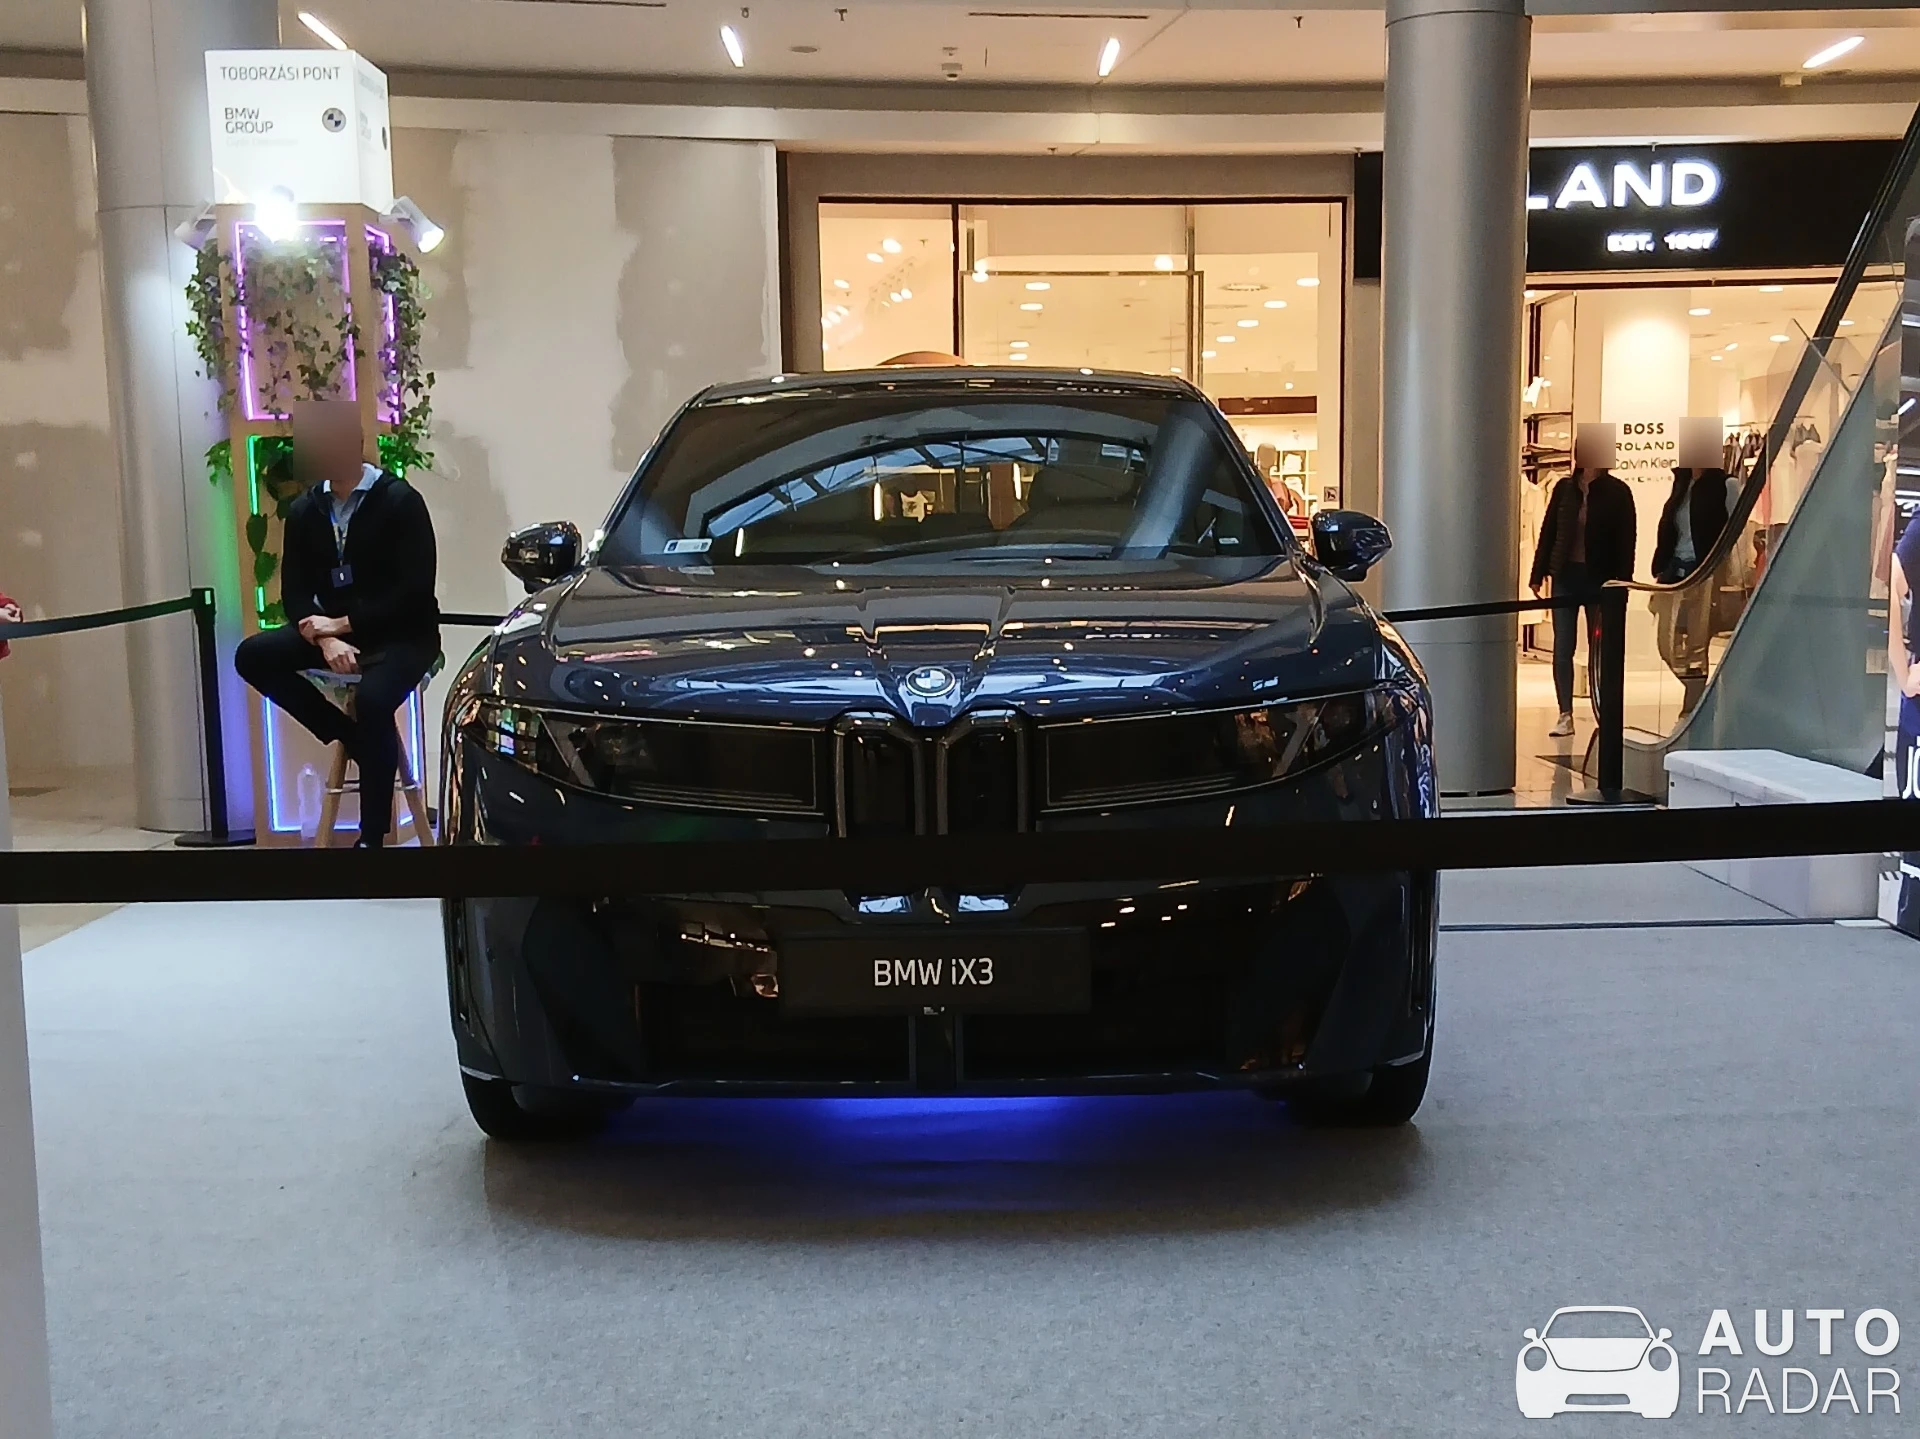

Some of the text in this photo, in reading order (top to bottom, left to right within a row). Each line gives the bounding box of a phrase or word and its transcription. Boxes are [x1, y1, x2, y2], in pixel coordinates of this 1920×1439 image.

[220, 64, 341, 81] TOBORZÁSI PONT
[224, 107, 261, 120] BMW
[225, 120, 274, 134] GROUP
[1623, 422, 1664, 435] BOSS
[874, 957, 994, 987] BMW iX3
